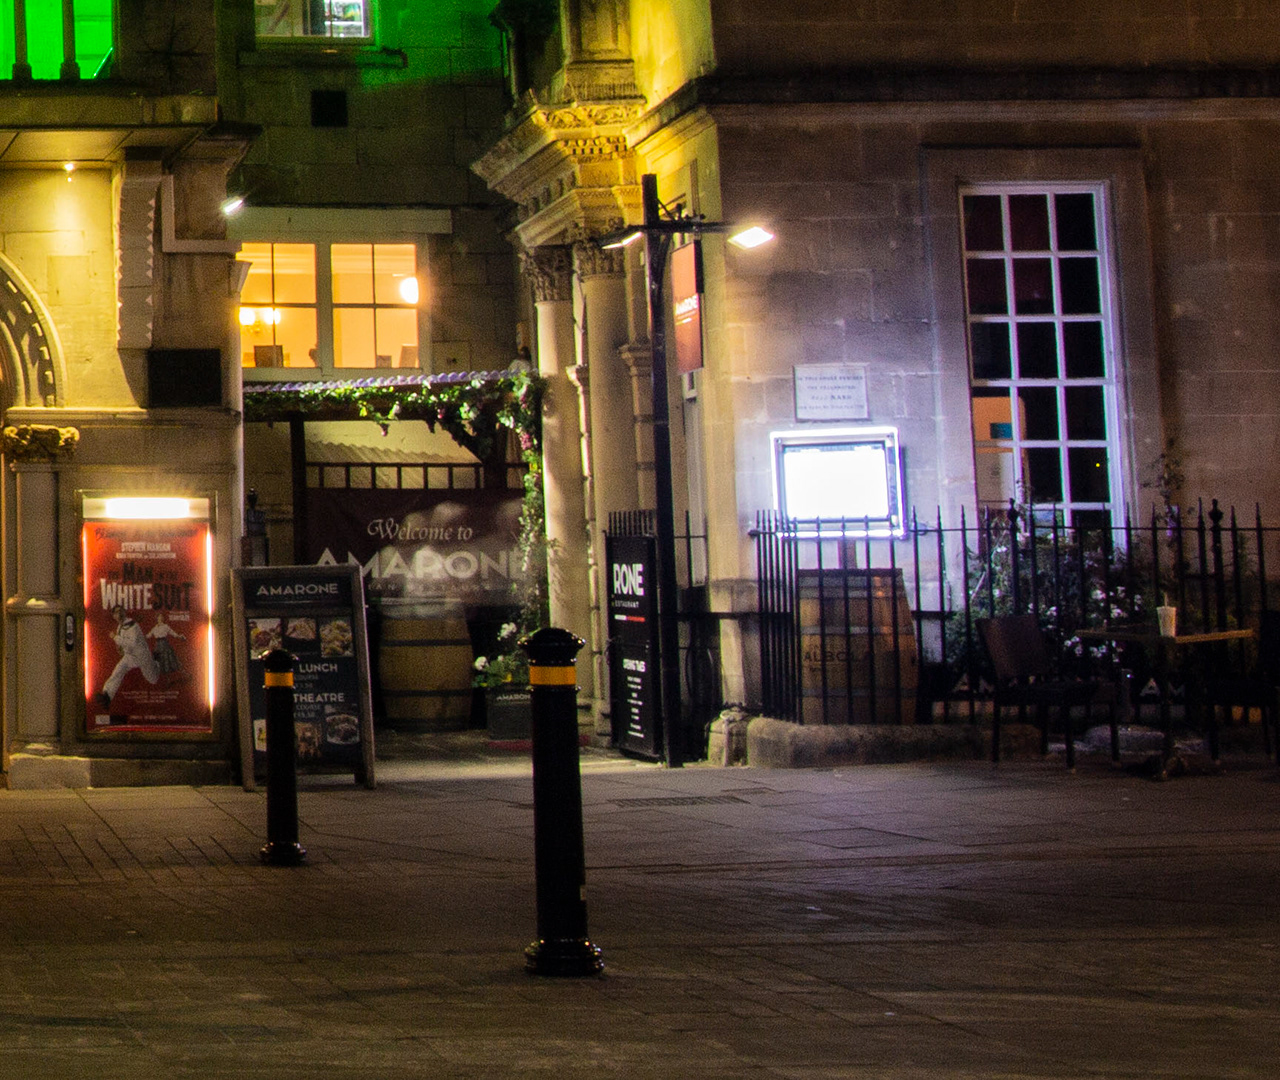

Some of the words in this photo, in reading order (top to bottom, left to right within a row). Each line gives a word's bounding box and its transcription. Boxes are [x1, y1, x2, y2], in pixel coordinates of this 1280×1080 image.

[366, 517, 453, 542] Welcome
[456, 525, 474, 541] to
[315, 547, 529, 579] AMARONE
[100, 578, 153, 610] WHITE
[152, 582, 195, 611] SUIT
[256, 583, 339, 596] AMARONE
[298, 663, 339, 673] LUNCH
[293, 692, 345, 703] THEATRE
[496, 693, 531, 701] AMARON
